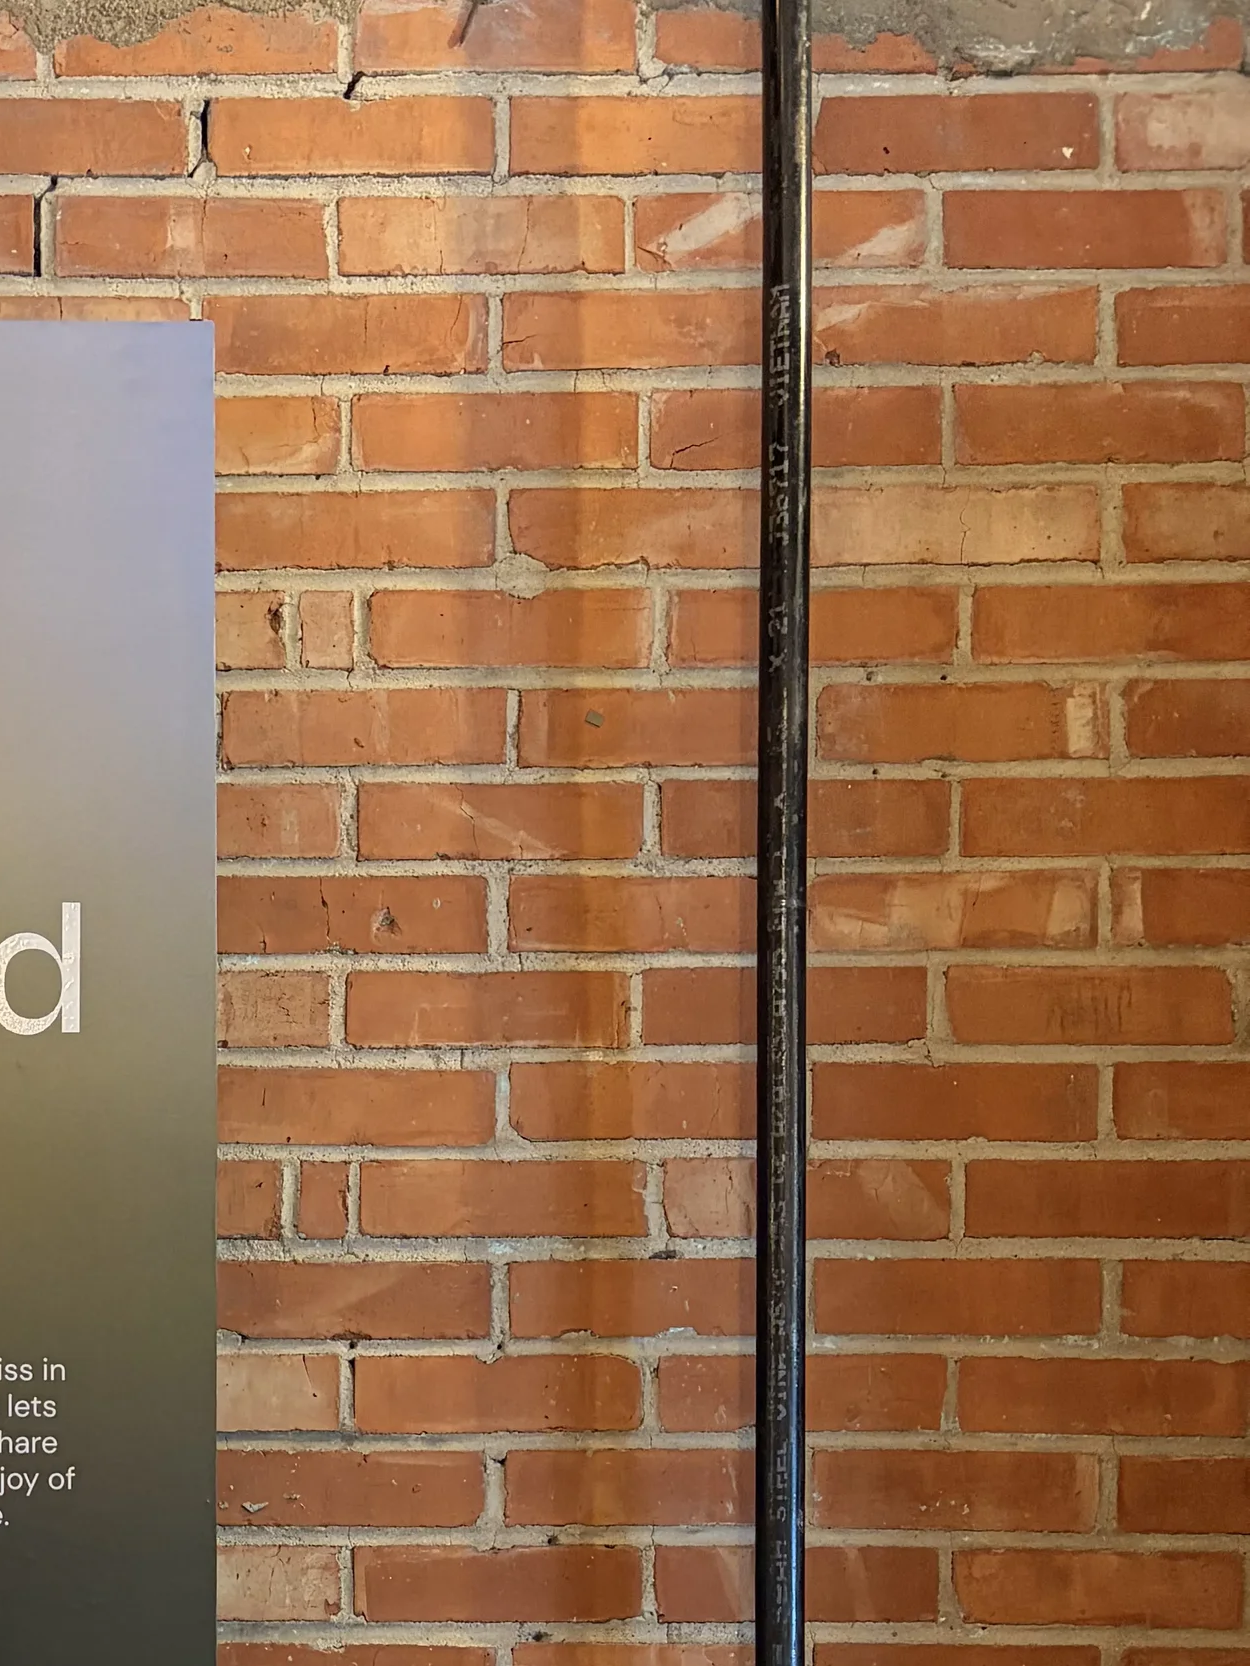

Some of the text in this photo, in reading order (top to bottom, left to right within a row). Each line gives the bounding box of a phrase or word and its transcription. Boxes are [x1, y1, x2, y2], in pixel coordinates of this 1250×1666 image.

[43, 1357, 66, 1381] in
[8, 1393, 57, 1418] lets
[48, 1465, 76, 1491] of
